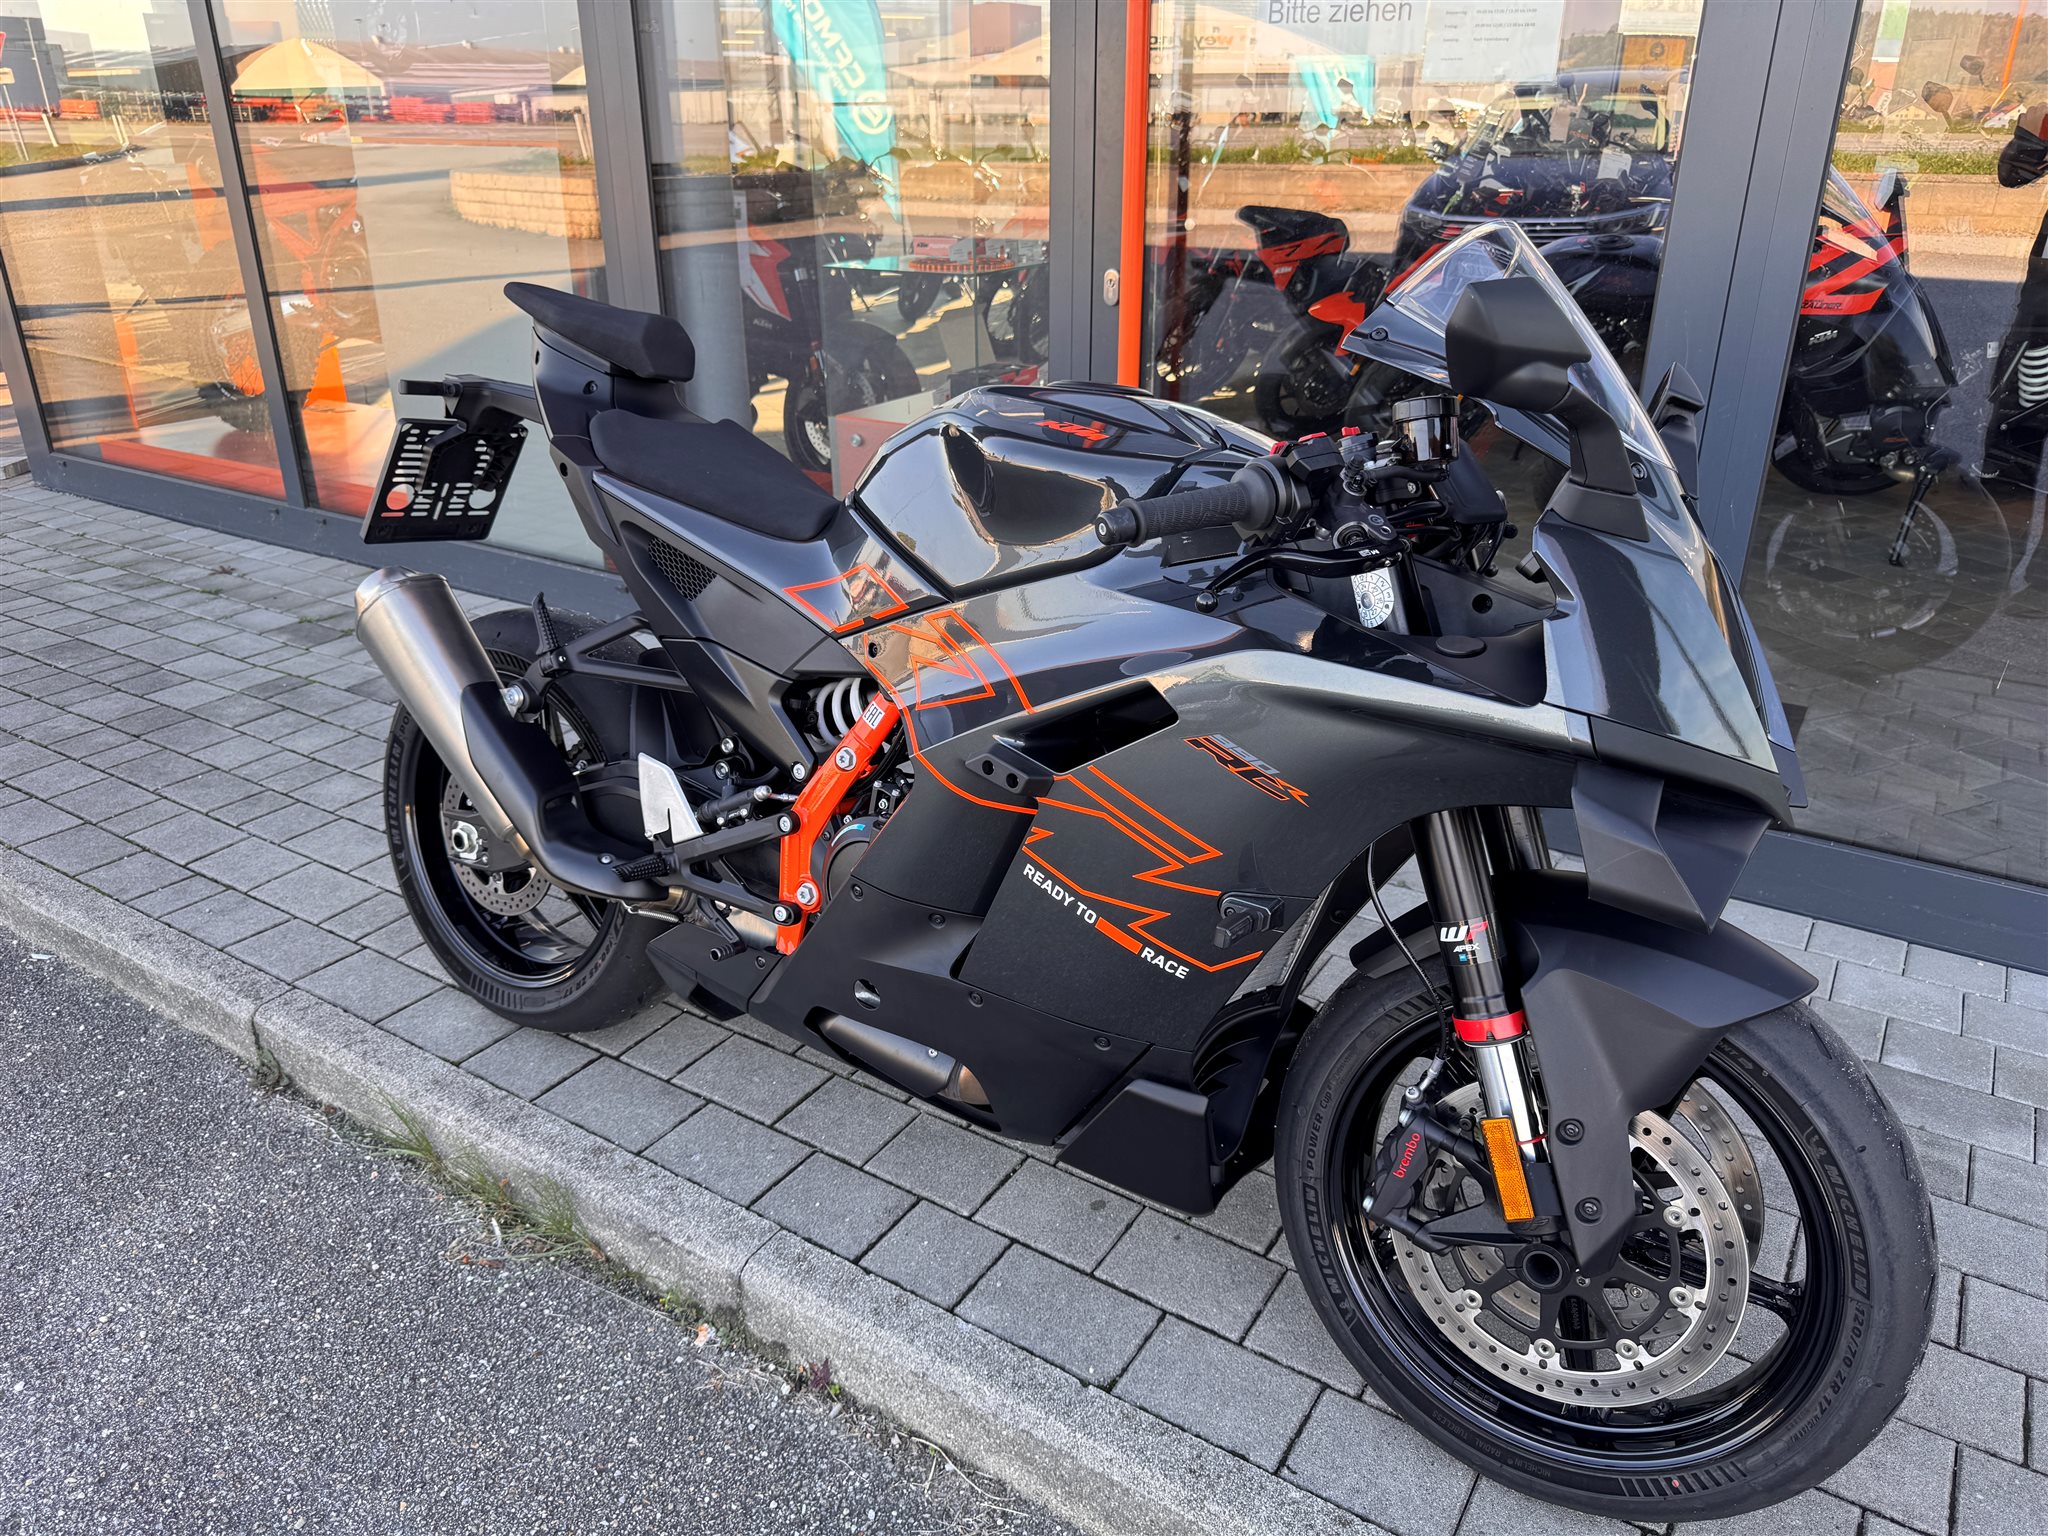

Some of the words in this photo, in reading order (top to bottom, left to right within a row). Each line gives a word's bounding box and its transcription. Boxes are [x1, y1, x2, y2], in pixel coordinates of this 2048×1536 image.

[1268, 2, 1321, 25] Bitte
[1328, 0, 1412, 24] ziehen
[1208, 733, 1281, 775] 990
[389, 741, 403, 845] MICHELIN
[1023, 863, 1075, 907] READY
[1076, 901, 1097, 924] TO
[1140, 946, 1190, 979] RACE
[1453, 942, 1480, 953] APEX
[1306, 1114, 1324, 1172] POWER
[1392, 1133, 1421, 1178] brembo
[1304, 1182, 1341, 1294] MICHELIN
[1824, 1163, 1868, 1295] MICHELIN
[1845, 1304, 1867, 1370] 120/70
[1818, 1395, 1832, 1416] 17
[1830, 1370, 1847, 1395] ZR
